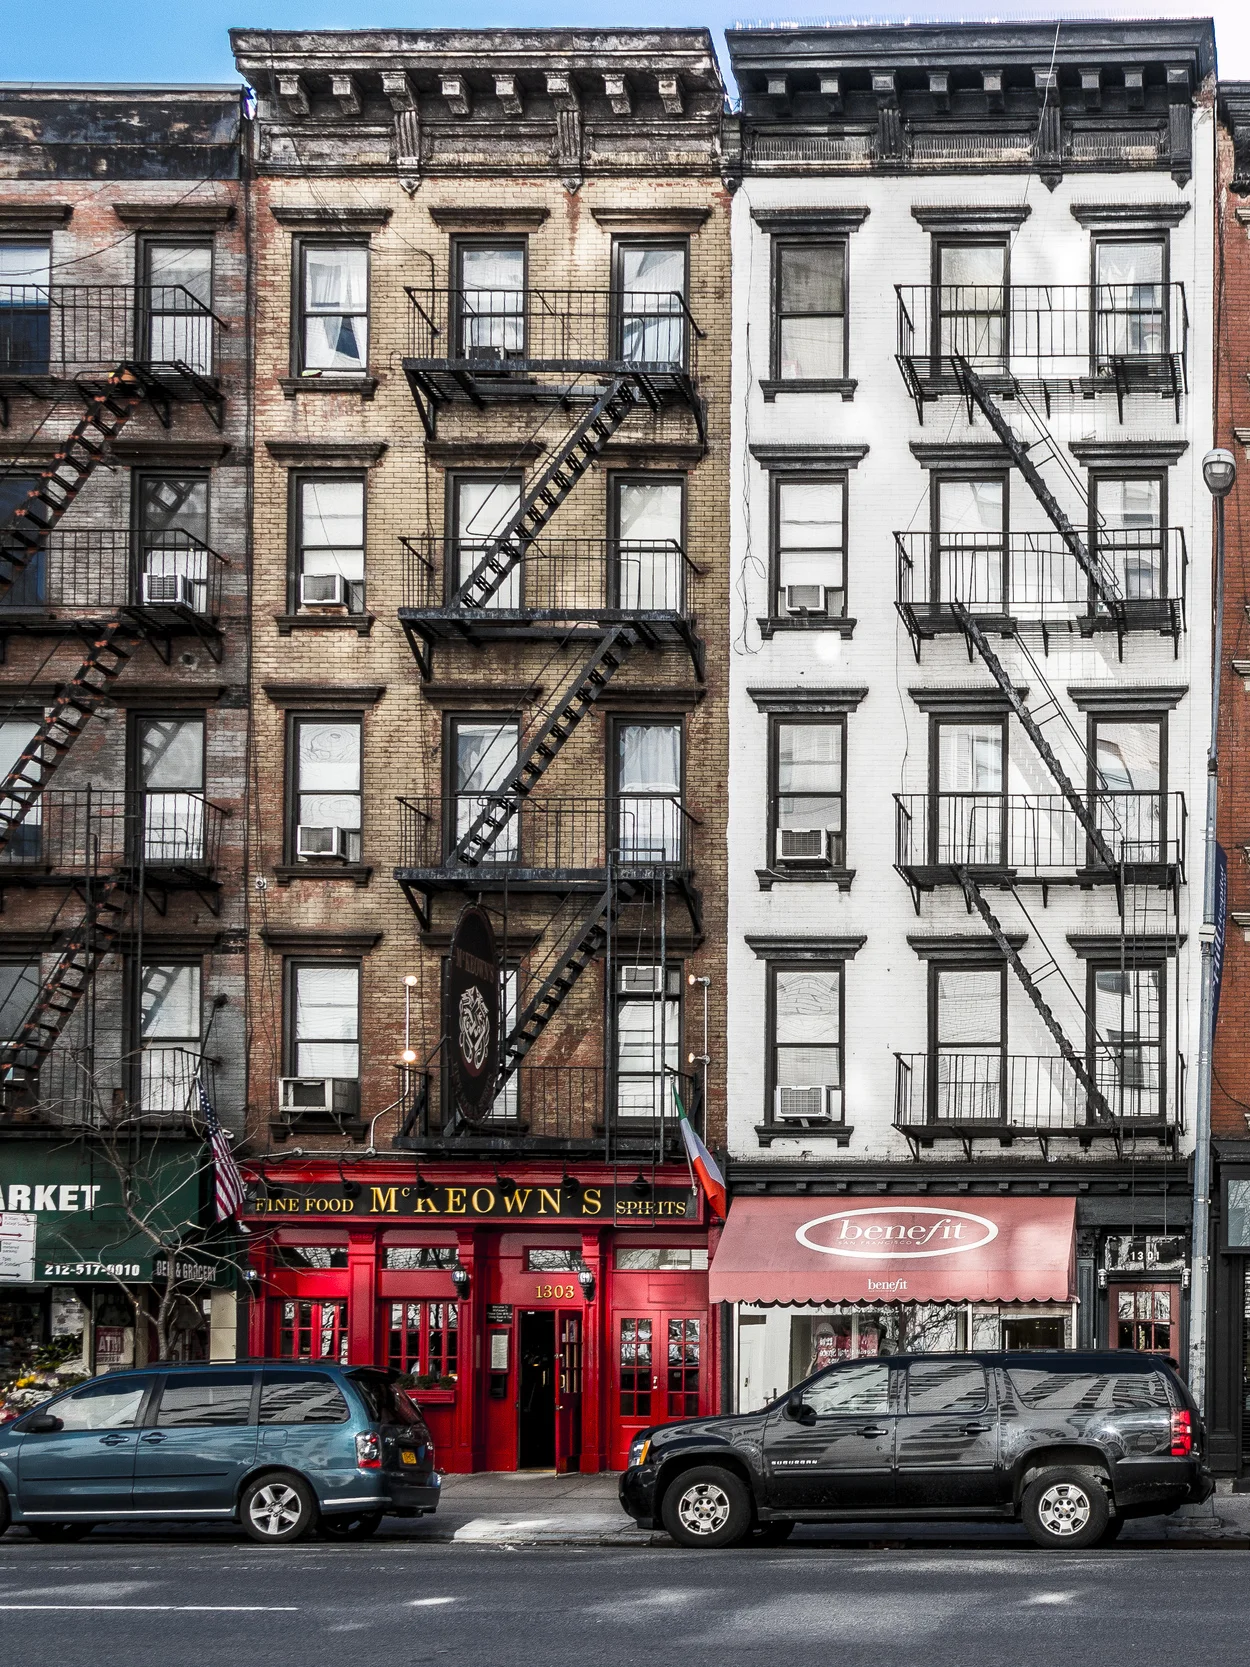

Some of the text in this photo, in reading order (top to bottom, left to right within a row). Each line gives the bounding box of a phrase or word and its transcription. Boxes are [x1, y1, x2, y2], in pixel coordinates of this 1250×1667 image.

[255, 1197, 300, 1212] FINE
[305, 1198, 354, 1213] FOOD
[616, 1200, 686, 1216] SPIRITS
[837, 1218, 968, 1246] benefit
[1130, 1251, 1160, 1260] 1301
[176, 1262, 181, 1278] &
[183, 1263, 216, 1281] GROCERY
[536, 1284, 575, 1299] 1303
[868, 1278, 908, 1292] benefit
[99, 1336, 121, 1352] ATM
